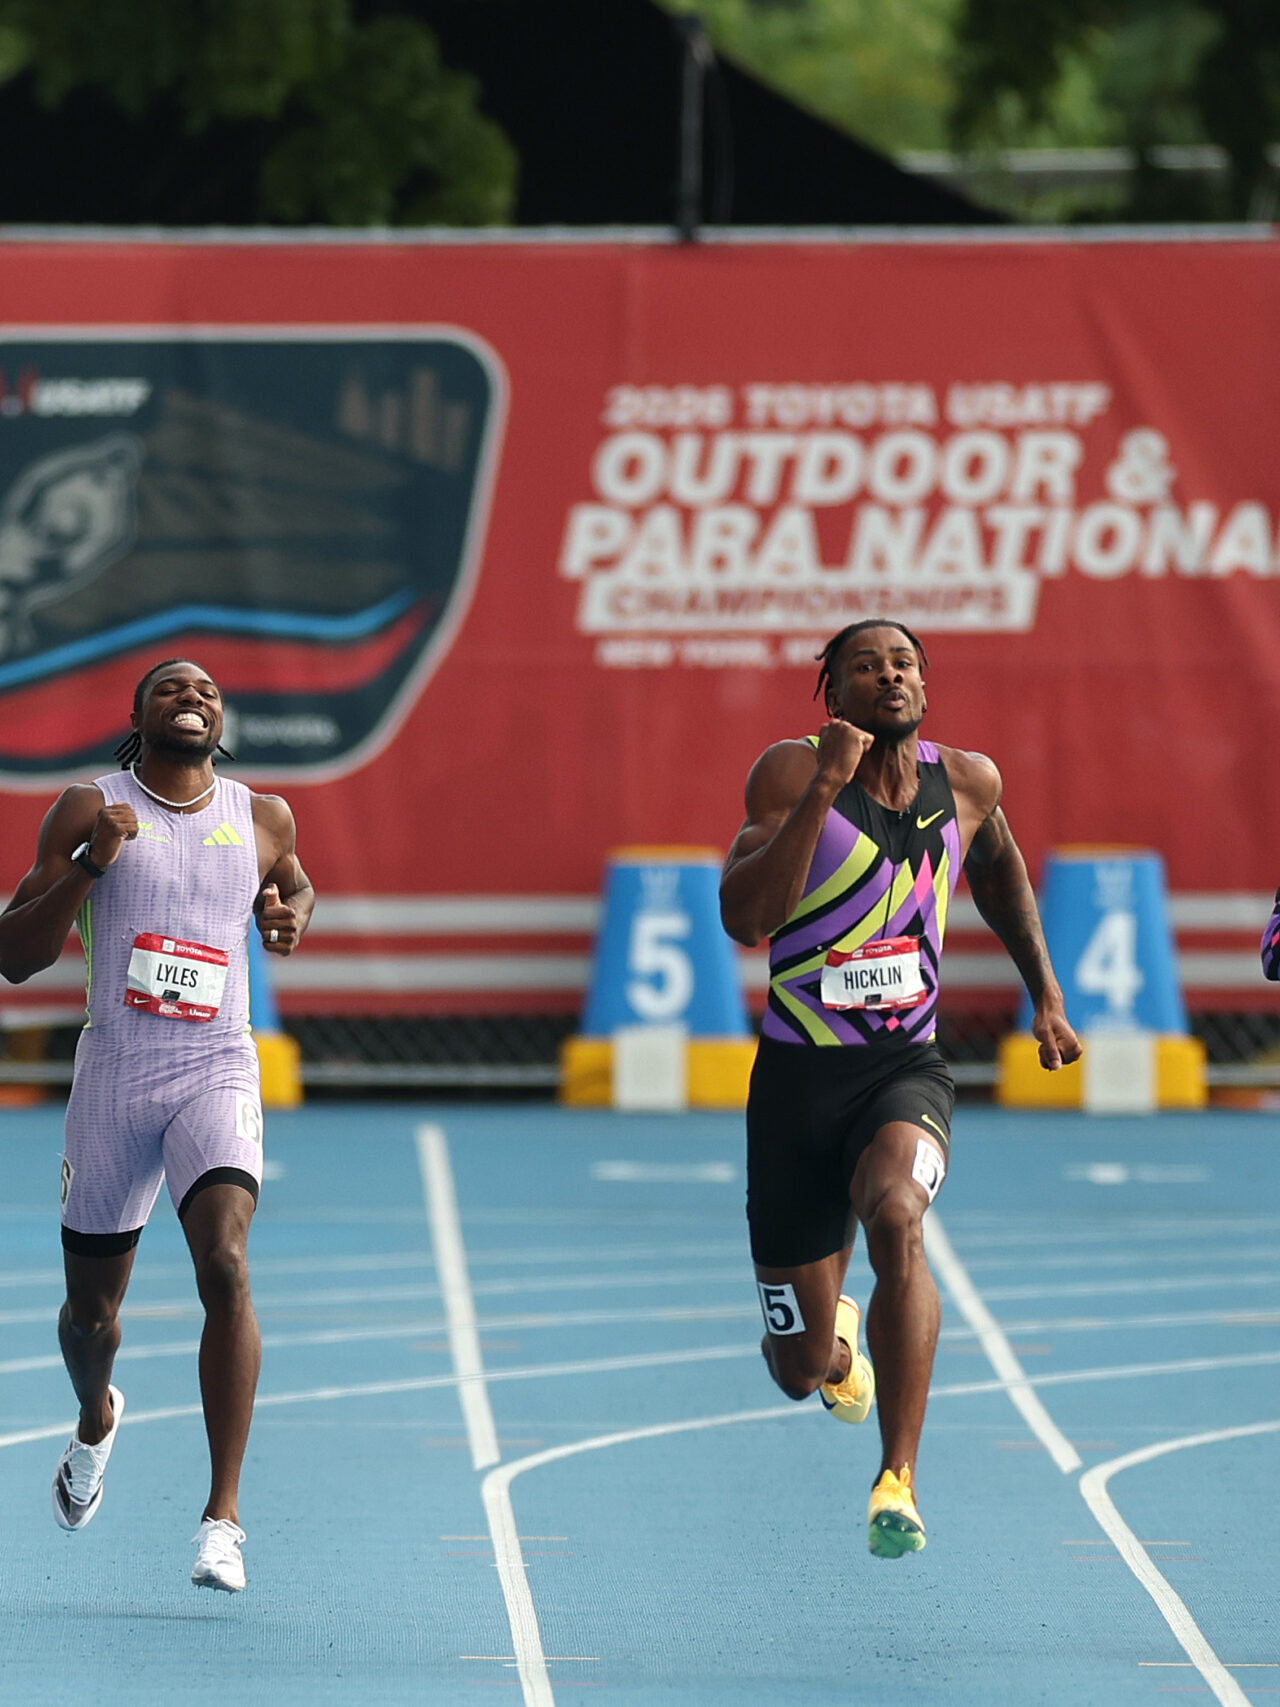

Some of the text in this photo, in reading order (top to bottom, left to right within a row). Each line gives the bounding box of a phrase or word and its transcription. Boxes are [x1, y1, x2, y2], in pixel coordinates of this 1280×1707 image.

[743, 382, 937, 428] TOYOTA
[946, 381, 1112, 426] USATF
[592, 426, 1176, 505] OUTDOOR &
[560, 500, 1280, 580] PARA NATIONA
[156, 963, 199, 988] LYLES
[627, 911, 694, 1019] 5
[844, 965, 903, 990] HICKLIN
[1075, 910, 1144, 1011] 4
[763, 1287, 795, 1332] 5
